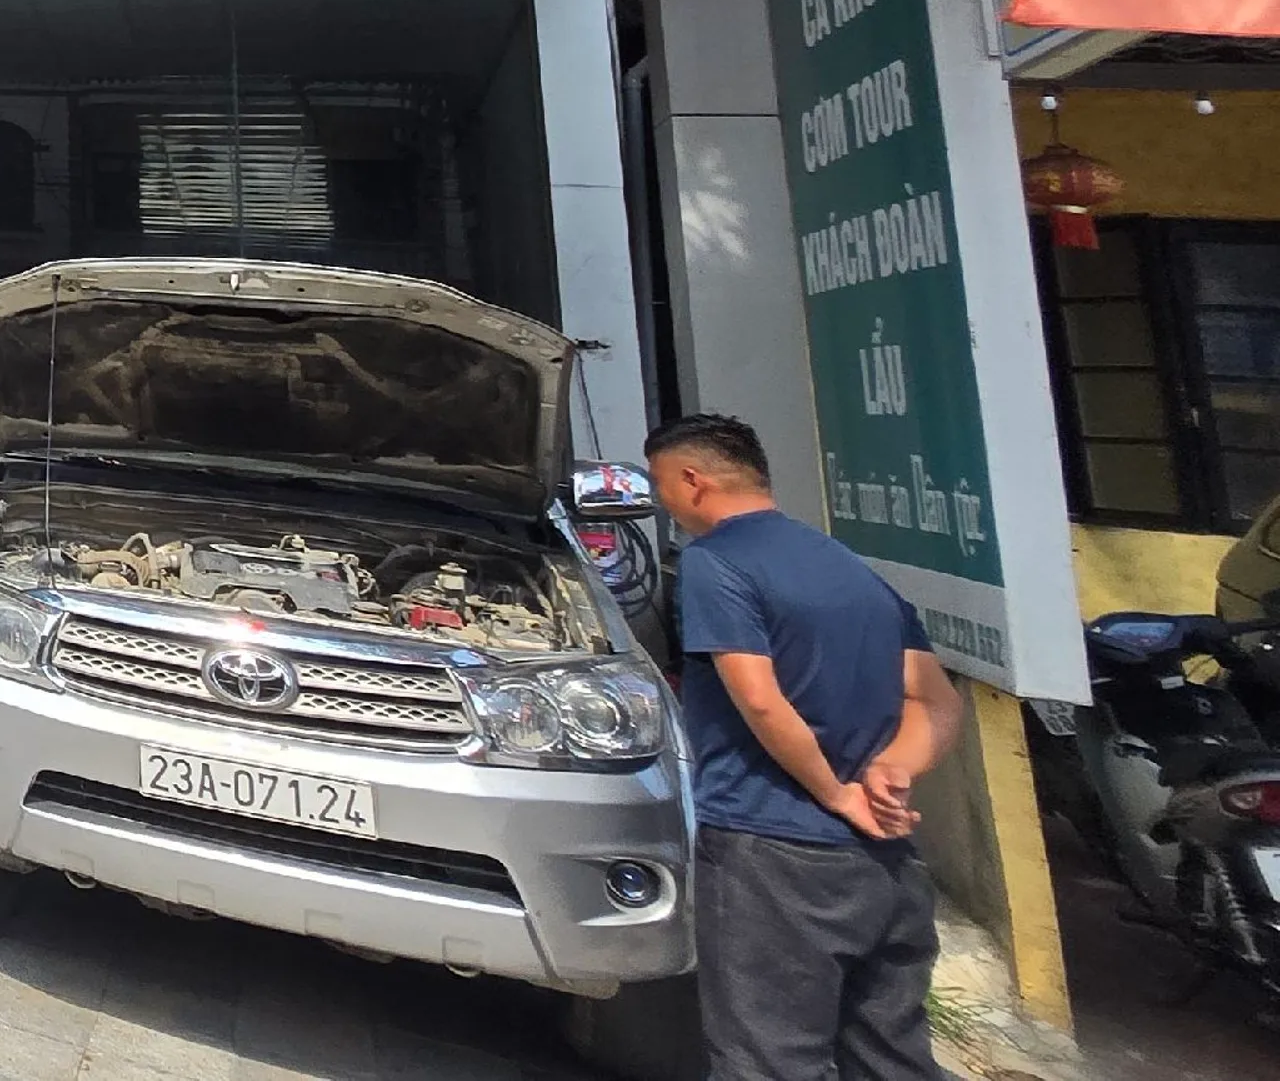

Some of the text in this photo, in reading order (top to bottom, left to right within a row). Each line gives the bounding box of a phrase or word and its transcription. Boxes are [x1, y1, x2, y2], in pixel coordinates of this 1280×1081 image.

[801, 59, 913, 172] CƠM TOUR
[802, 182, 948, 296] KHÁCH ĐOÀN
[148, 754, 367, 828] 23A-071.24
